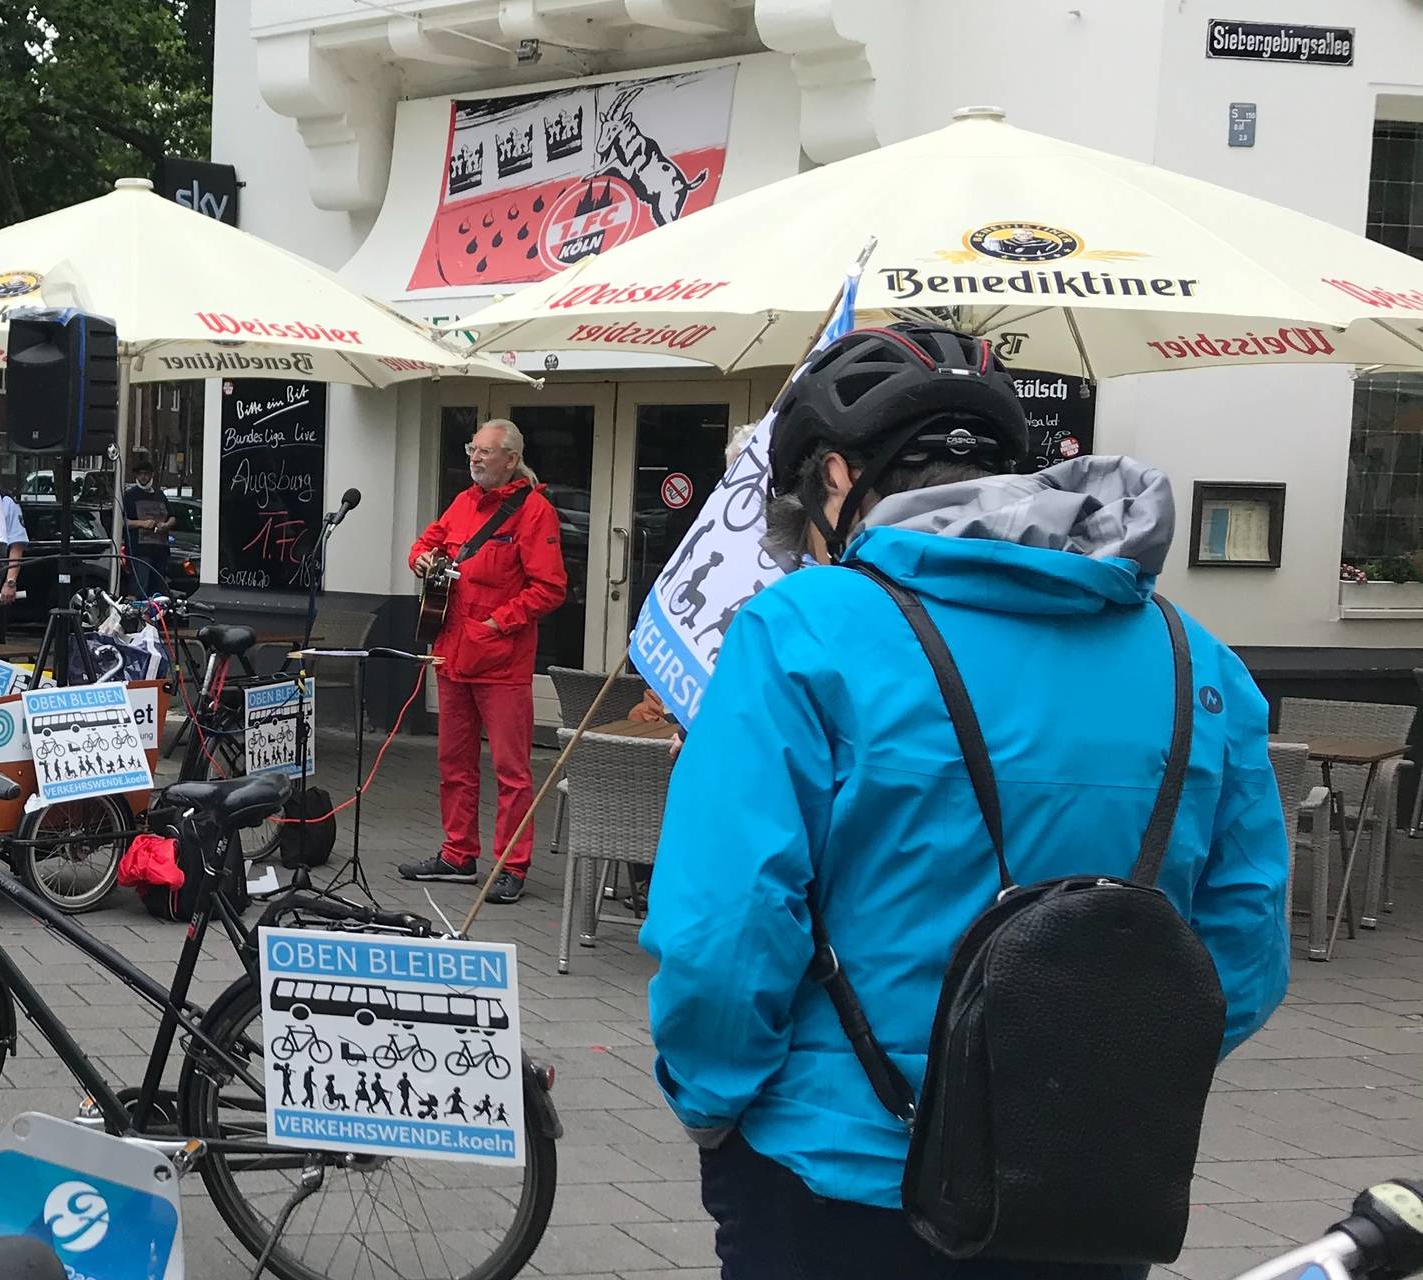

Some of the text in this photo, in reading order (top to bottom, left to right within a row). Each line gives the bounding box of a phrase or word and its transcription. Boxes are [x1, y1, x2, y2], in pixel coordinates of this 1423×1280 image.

[1213, 25, 1351, 59] Siebengebirgsallee
[175, 179, 229, 221] sky
[558, 234, 604, 260] KÖLN
[548, 278, 731, 310] Weissbier
[878, 267, 1201, 300] Benediktiner
[194, 310, 364, 345] Weissbier
[236, 385, 310, 420] Bitte ein Bit
[230, 457, 317, 509] Augsburg
[28, 689, 124, 712] OBEN BLEIBEN
[249, 688, 276, 706] OBEN
[43, 773, 149, 799] VERKEHRSWENDE.koeln
[271, 940, 503, 983] OBEN BLEIBEN
[277, 1114, 516, 1152] VERKEHRSWENDE.koeln
